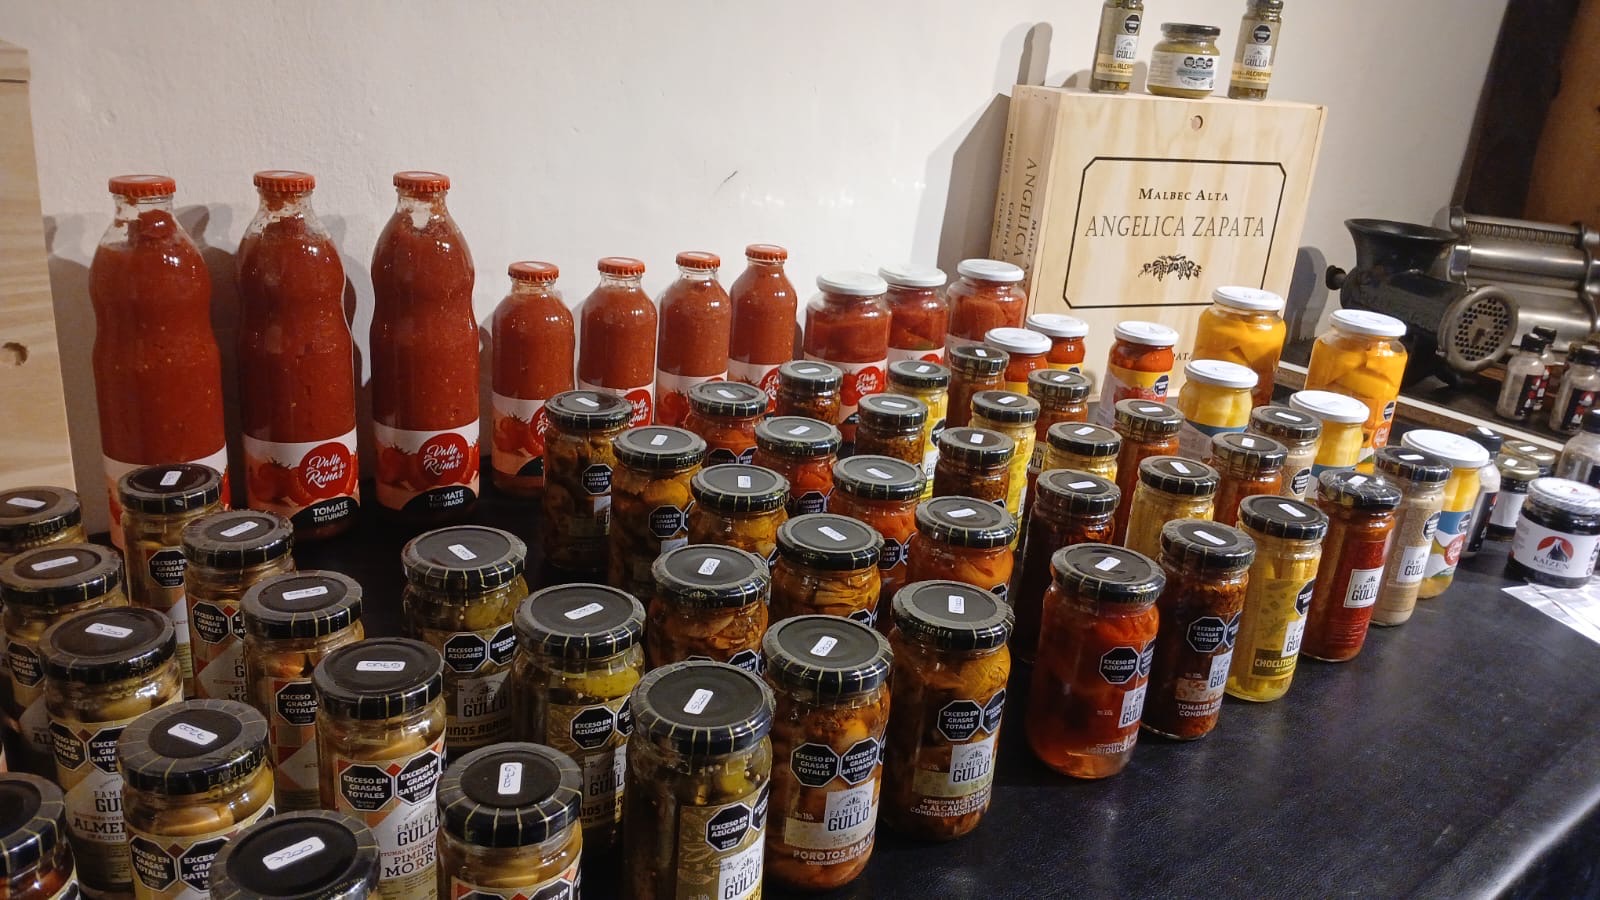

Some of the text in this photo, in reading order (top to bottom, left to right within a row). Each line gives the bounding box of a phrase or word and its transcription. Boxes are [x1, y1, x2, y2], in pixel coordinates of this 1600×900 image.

[1138, 188, 1228, 201] MALBEC ALTA
[1014, 157, 1038, 257] ANGELICA
[1085, 215, 1264, 237] ANGELICA ZAPATA
[426, 443, 458, 457] Valle
[308, 453, 341, 468] Valle
[424, 455, 462, 476] Reinas
[306, 467, 344, 488] Reinas
[312, 500, 348, 516] TOMATE
[313, 509, 349, 523] TRITURADO
[1532, 555, 1570, 570] KAIZEN
[796, 752, 824, 762] EXCESO
[846, 746, 877, 761] EXCESO EN
[850, 756, 873, 766] GRASAS
[800, 760, 829, 770] GRASAS
[954, 753, 991, 770] FAMIGLIA
[400, 758, 438, 781] EXCESO EN
[406, 768, 434, 786] GRASAS
[798, 766, 830, 776] TOTALES
[952, 760, 990, 782] GULLO
[344, 775, 374, 784] EXCESO
[348, 790, 385, 799] TOTALES
[349, 784, 383, 792] GRASAS
[830, 800, 870, 818] FAMIGLIA
[711, 815, 748, 831] EXCESO EN
[828, 806, 870, 832] GULLO
[394, 842, 436, 864] PIMIEN
[793, 849, 846, 860] POROTOS
[136, 863, 168, 878] TOTALES
[192, 862, 212, 870] GRA
[182, 872, 209, 880] SATU
